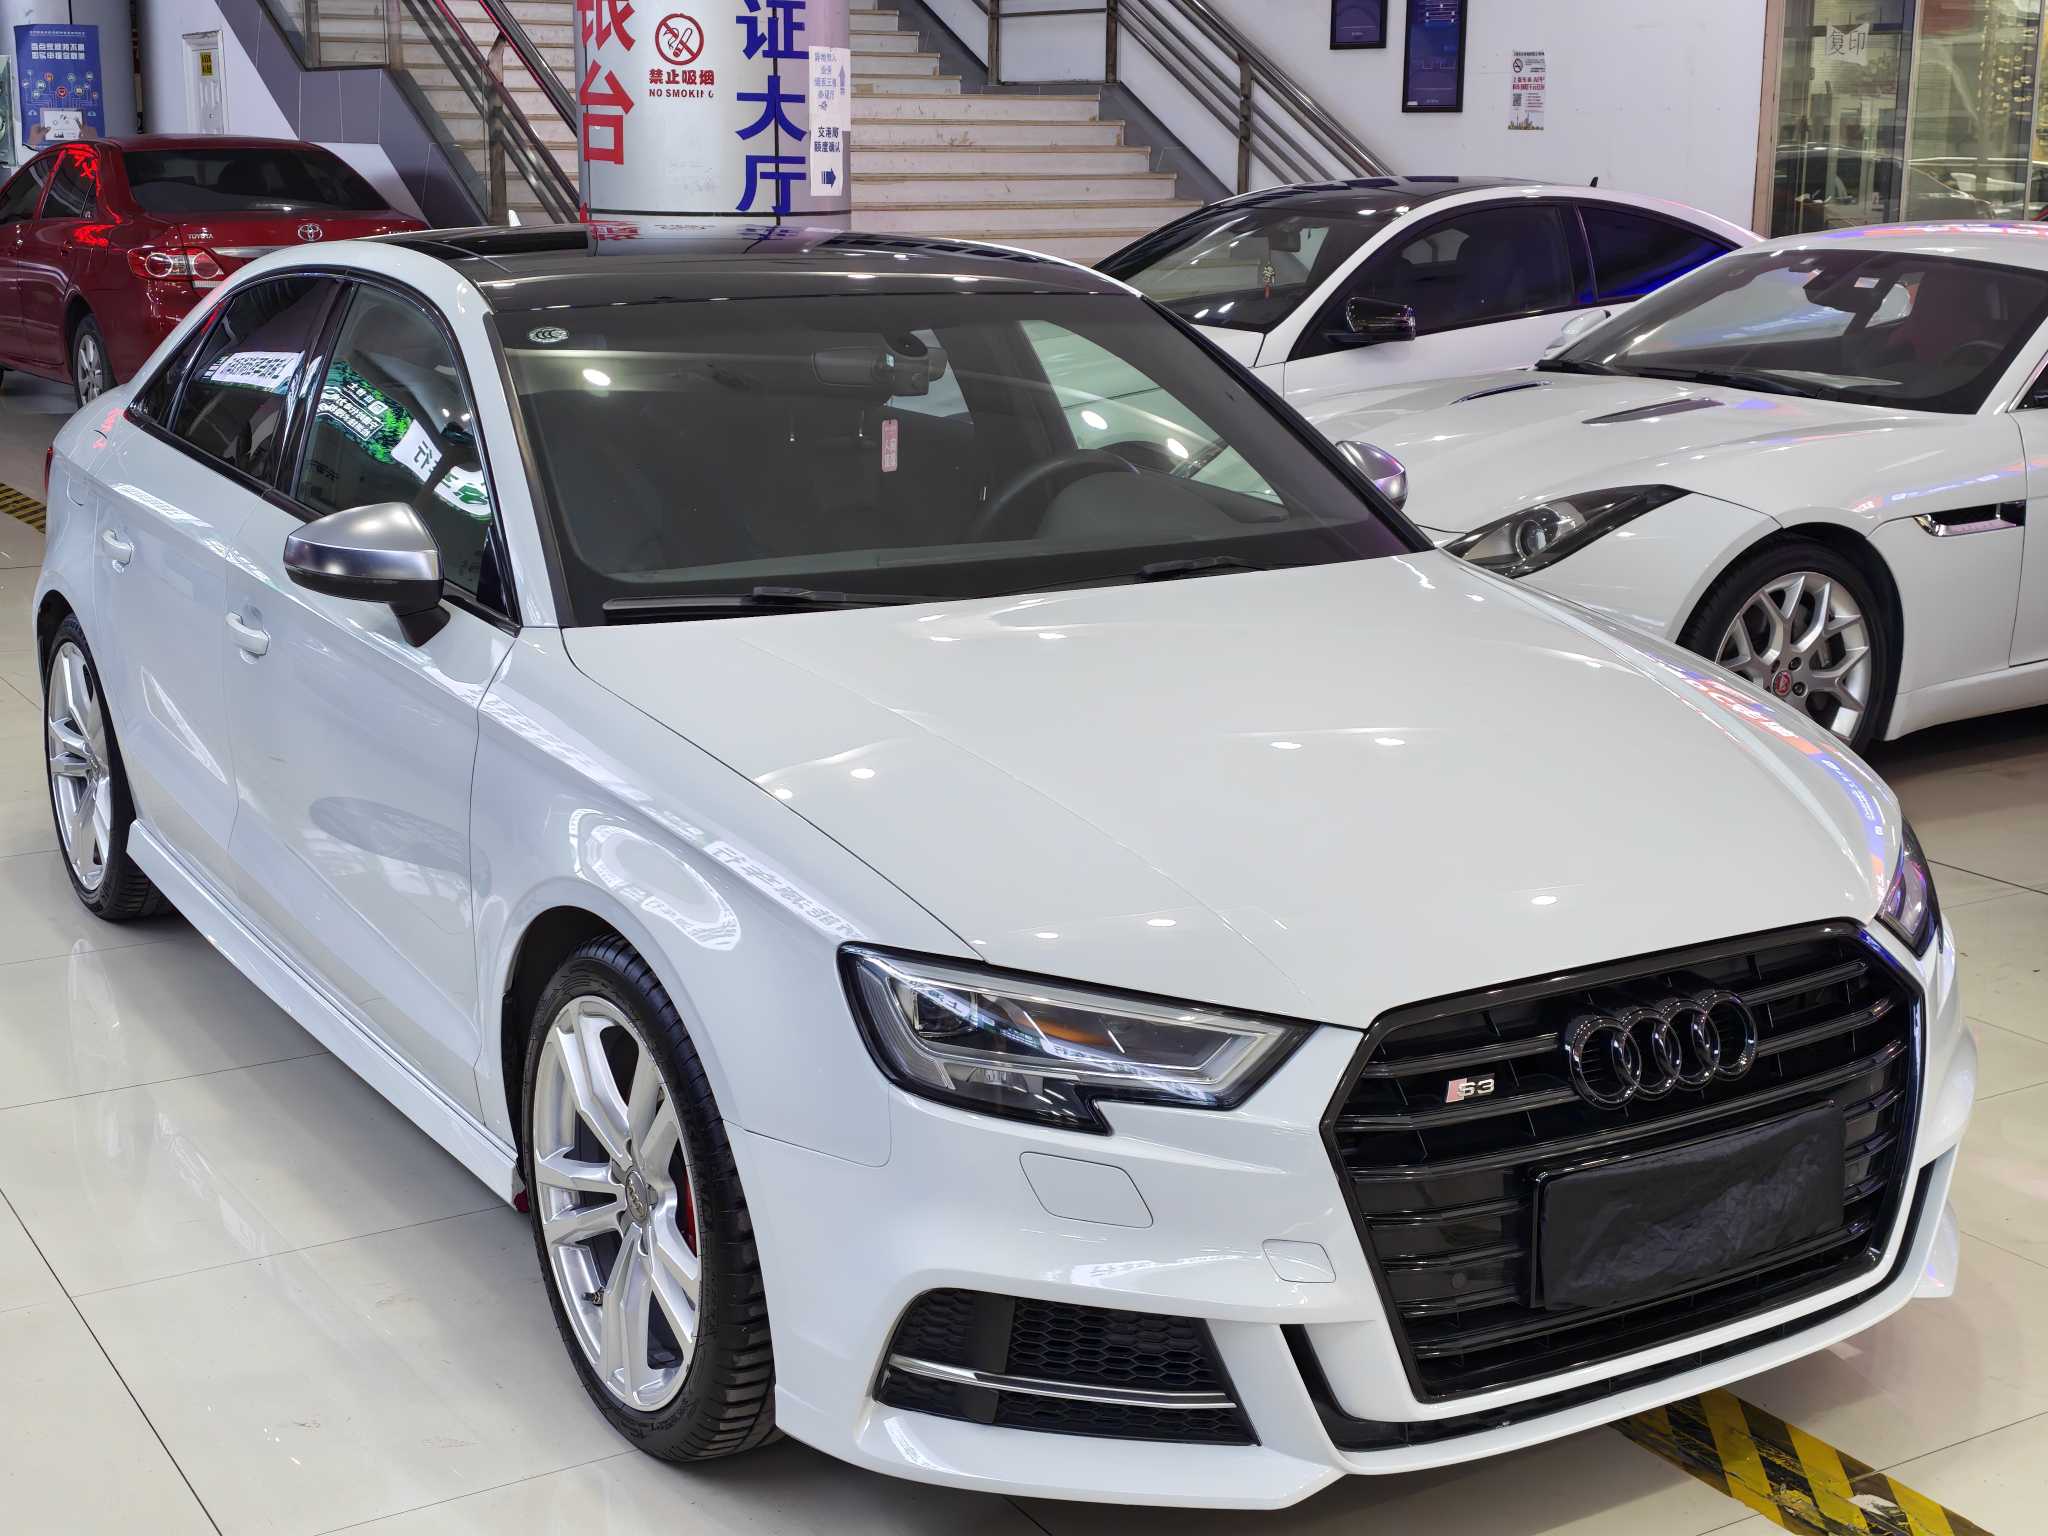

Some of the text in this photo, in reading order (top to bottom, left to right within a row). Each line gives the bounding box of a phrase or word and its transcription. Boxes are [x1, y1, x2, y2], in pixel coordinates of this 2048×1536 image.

[1828, 30, 1866, 55] 复印
[649, 68, 715, 86] 禁止吸烟
[649, 88, 663, 98] NO
[735, 0, 810, 215] 证大厅
[1455, 1077, 1496, 1098] S3
